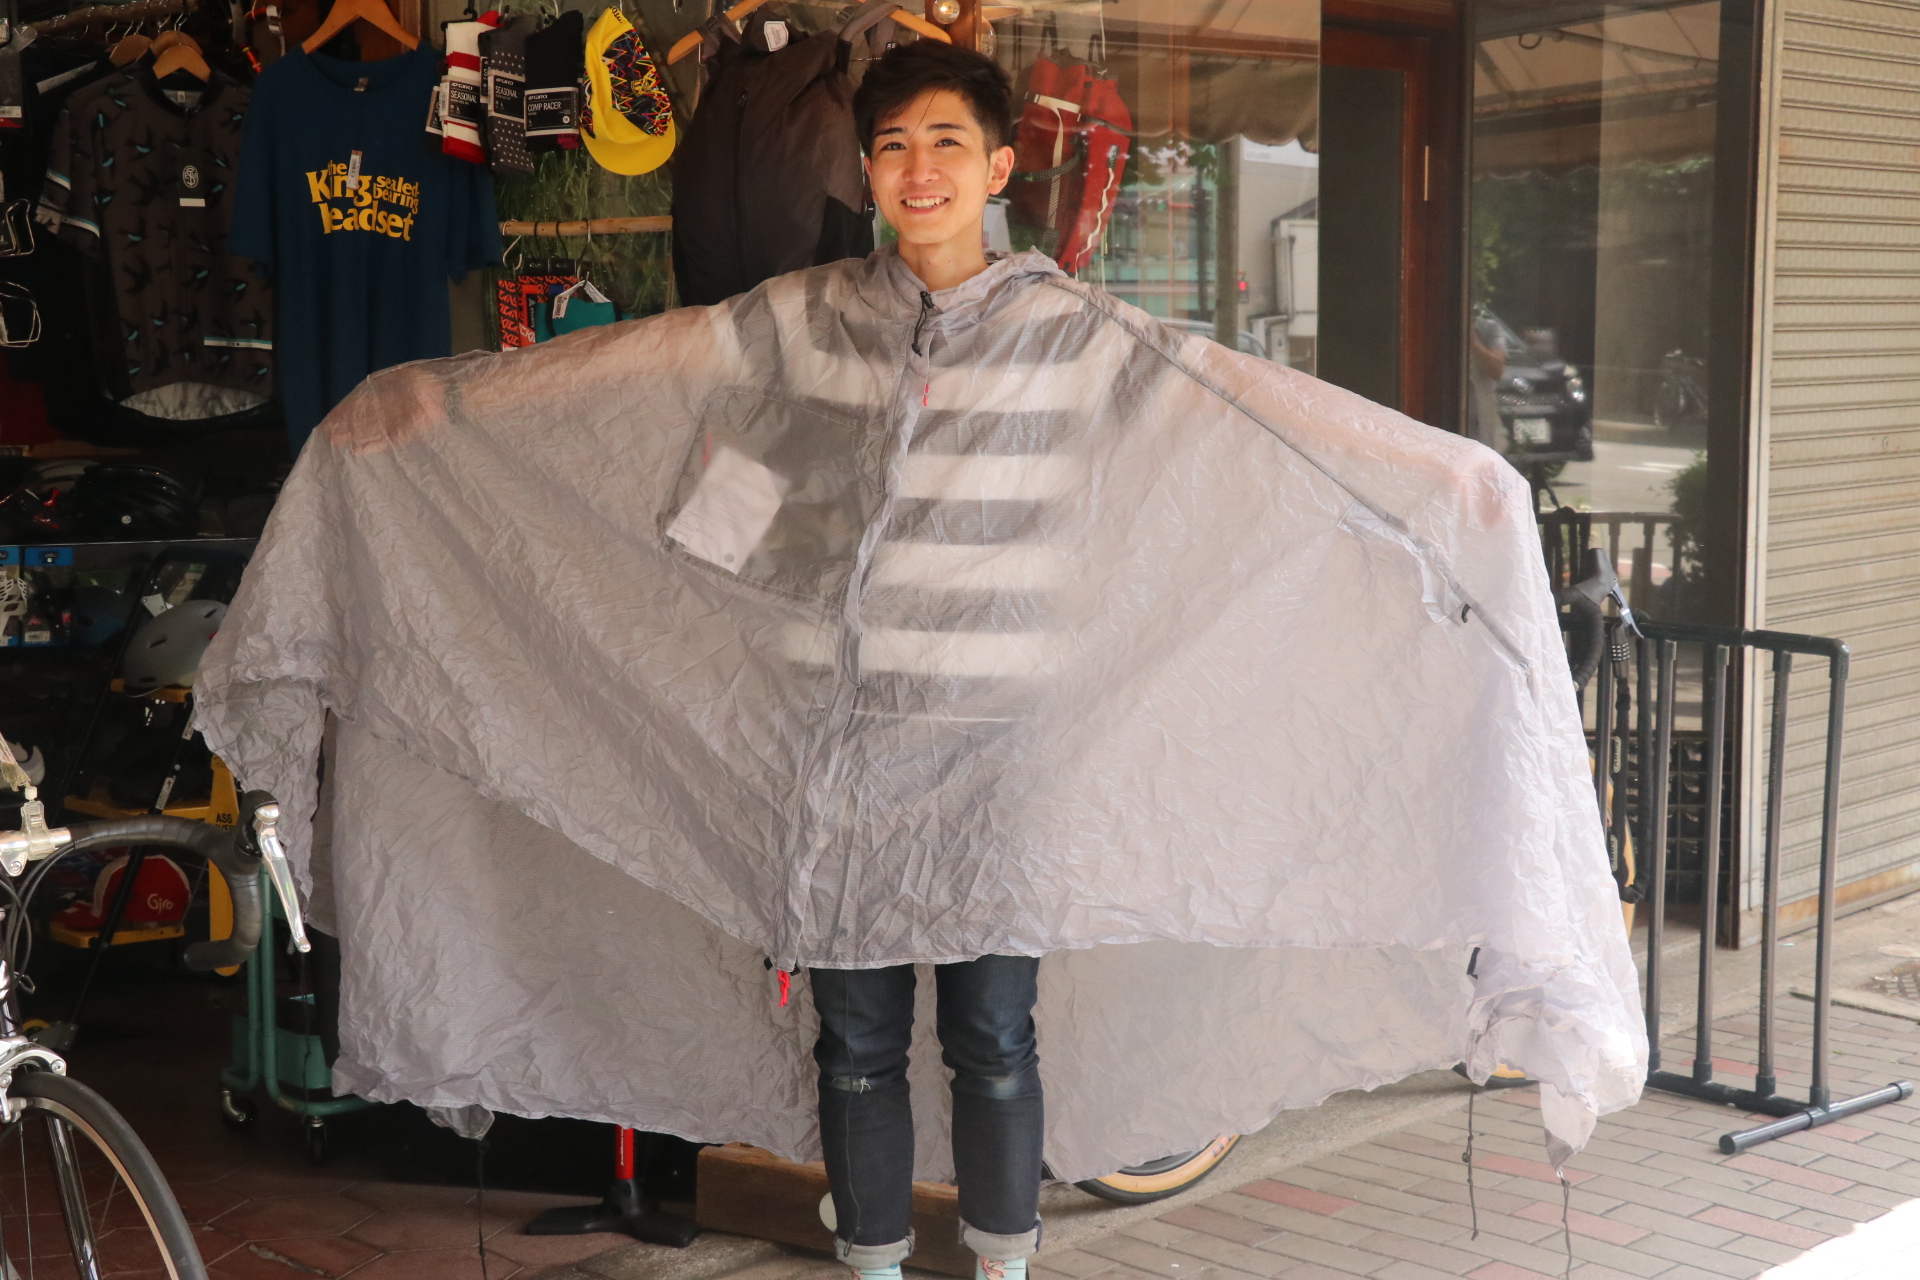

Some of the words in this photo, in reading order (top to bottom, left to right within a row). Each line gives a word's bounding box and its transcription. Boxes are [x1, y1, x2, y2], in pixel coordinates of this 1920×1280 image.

[450, 90, 477, 104] SEASONAL
[495, 85, 518, 99] SEASONAL
[528, 102, 543, 112] COMP
[543, 101, 562, 111] RACER
[327, 160, 348, 176] the
[305, 169, 373, 207] Kng
[373, 183, 419, 215] bearing
[216, 812, 233, 824] ASS
[147, 893, 174, 914] Giro
